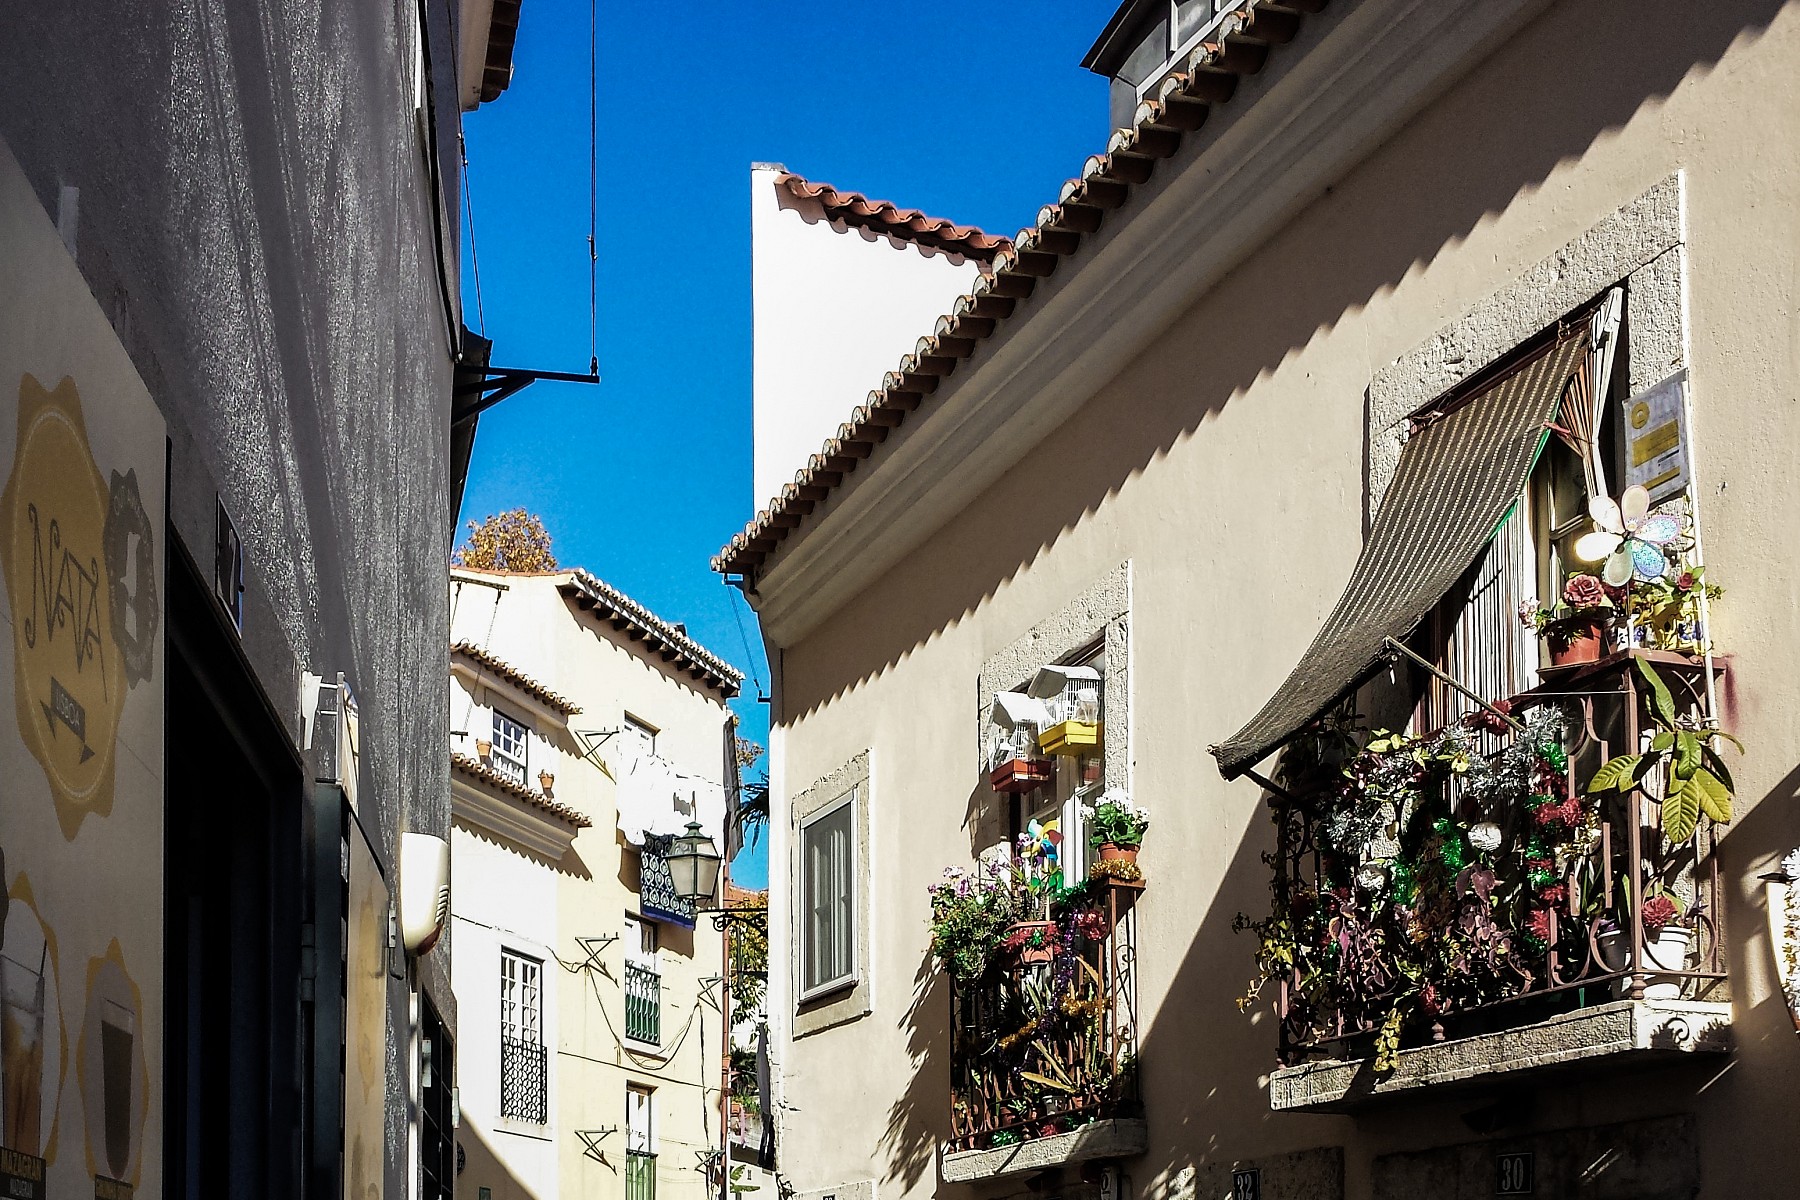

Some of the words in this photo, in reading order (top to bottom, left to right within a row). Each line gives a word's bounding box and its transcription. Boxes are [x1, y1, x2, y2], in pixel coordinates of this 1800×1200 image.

[25, 502, 107, 703] NATA
[56, 686, 81, 728] LISBOA
[1501, 1157, 1524, 1190] 30
